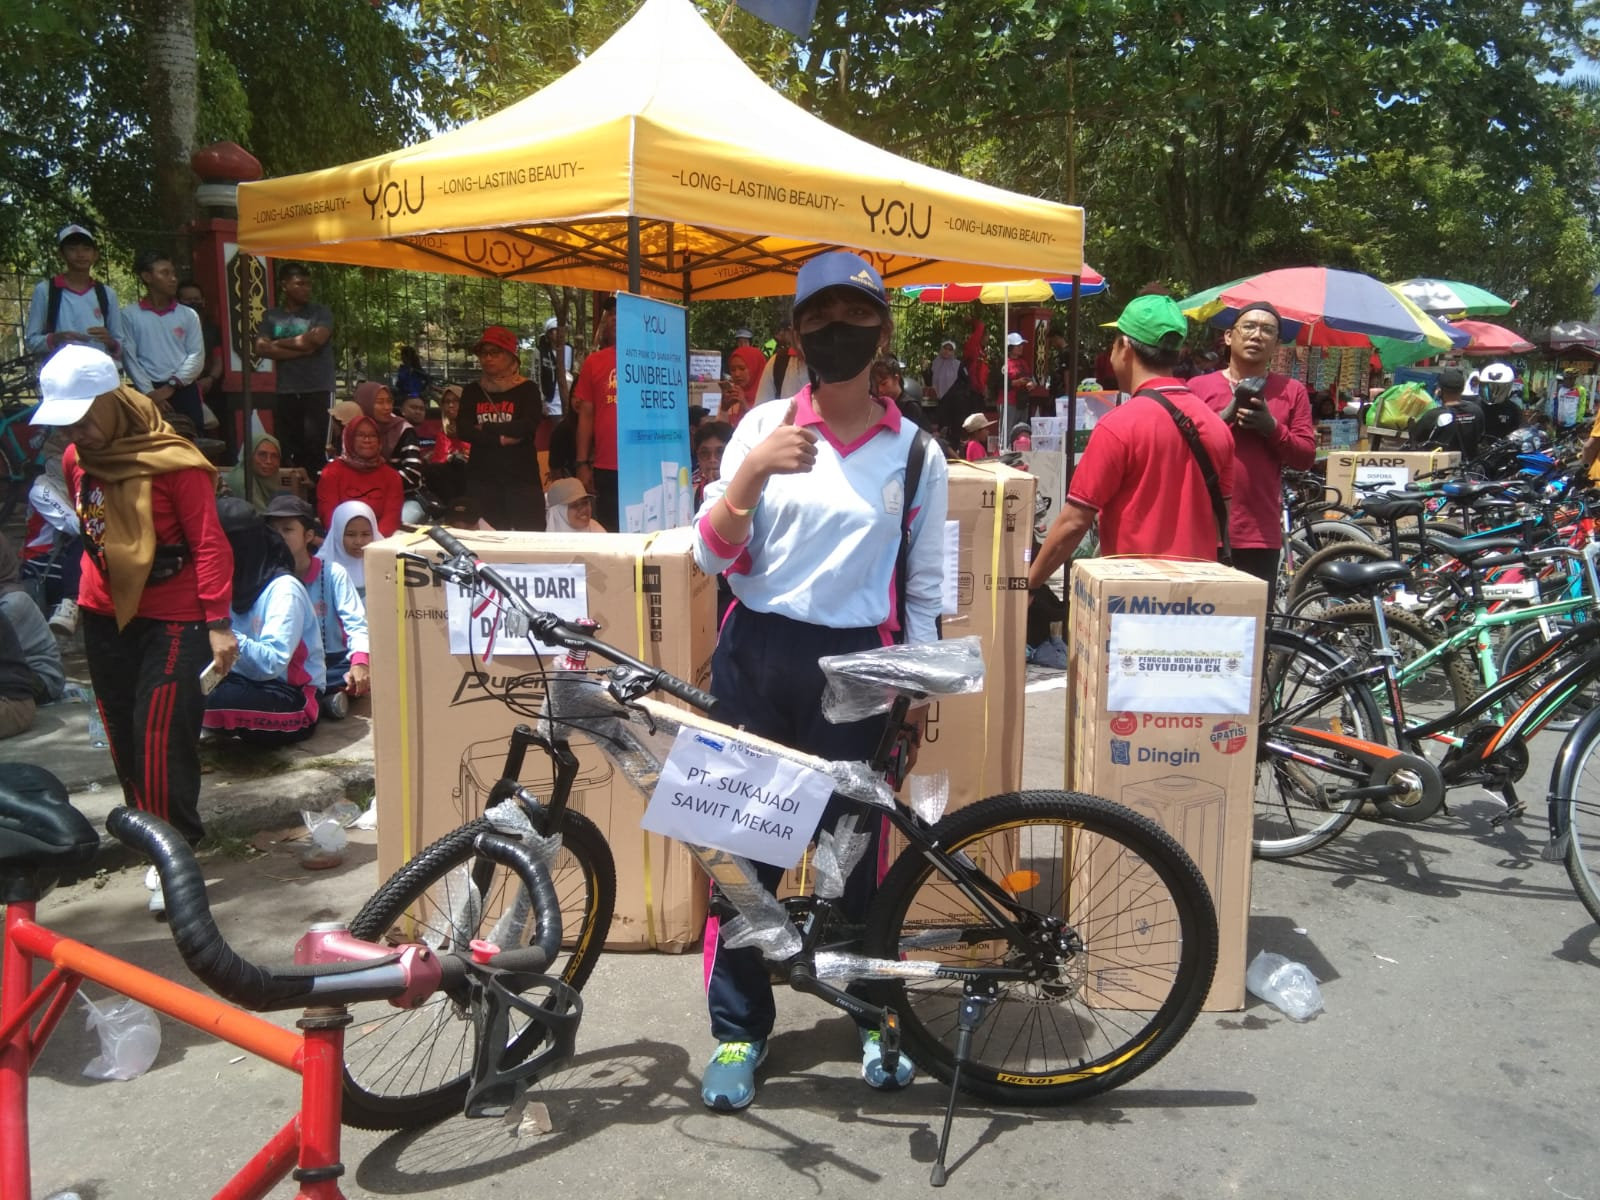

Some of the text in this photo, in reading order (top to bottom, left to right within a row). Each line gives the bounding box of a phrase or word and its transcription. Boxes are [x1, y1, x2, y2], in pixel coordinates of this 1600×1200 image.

[362, 175, 425, 220] Y.O.U
[860, 195, 931, 240] Y.O.U
[625, 363, 683, 387] SUNBRELLA
[640, 390, 676, 410] SERIES
[1340, 457, 1405, 468] SHARP
[534, 577, 576, 598] DARI
[1011, 579, 1027, 589] HS
[1130, 595, 1215, 615] Miyako
[165, 638, 180, 675] adidas
[1194, 657, 1221, 665] SAMPIT
[1138, 662, 1221, 673] SUYUDONO CK
[1142, 713, 1203, 728] Panas
[1210, 726, 1246, 742] GRATIS!
[1138, 747, 1200, 766] Dingin
[687, 767, 800, 815] PT. SUKAJADI
[671, 792, 794, 841] SAWIT MEKAR
[1001, 1075, 1056, 1084] TRENDY
